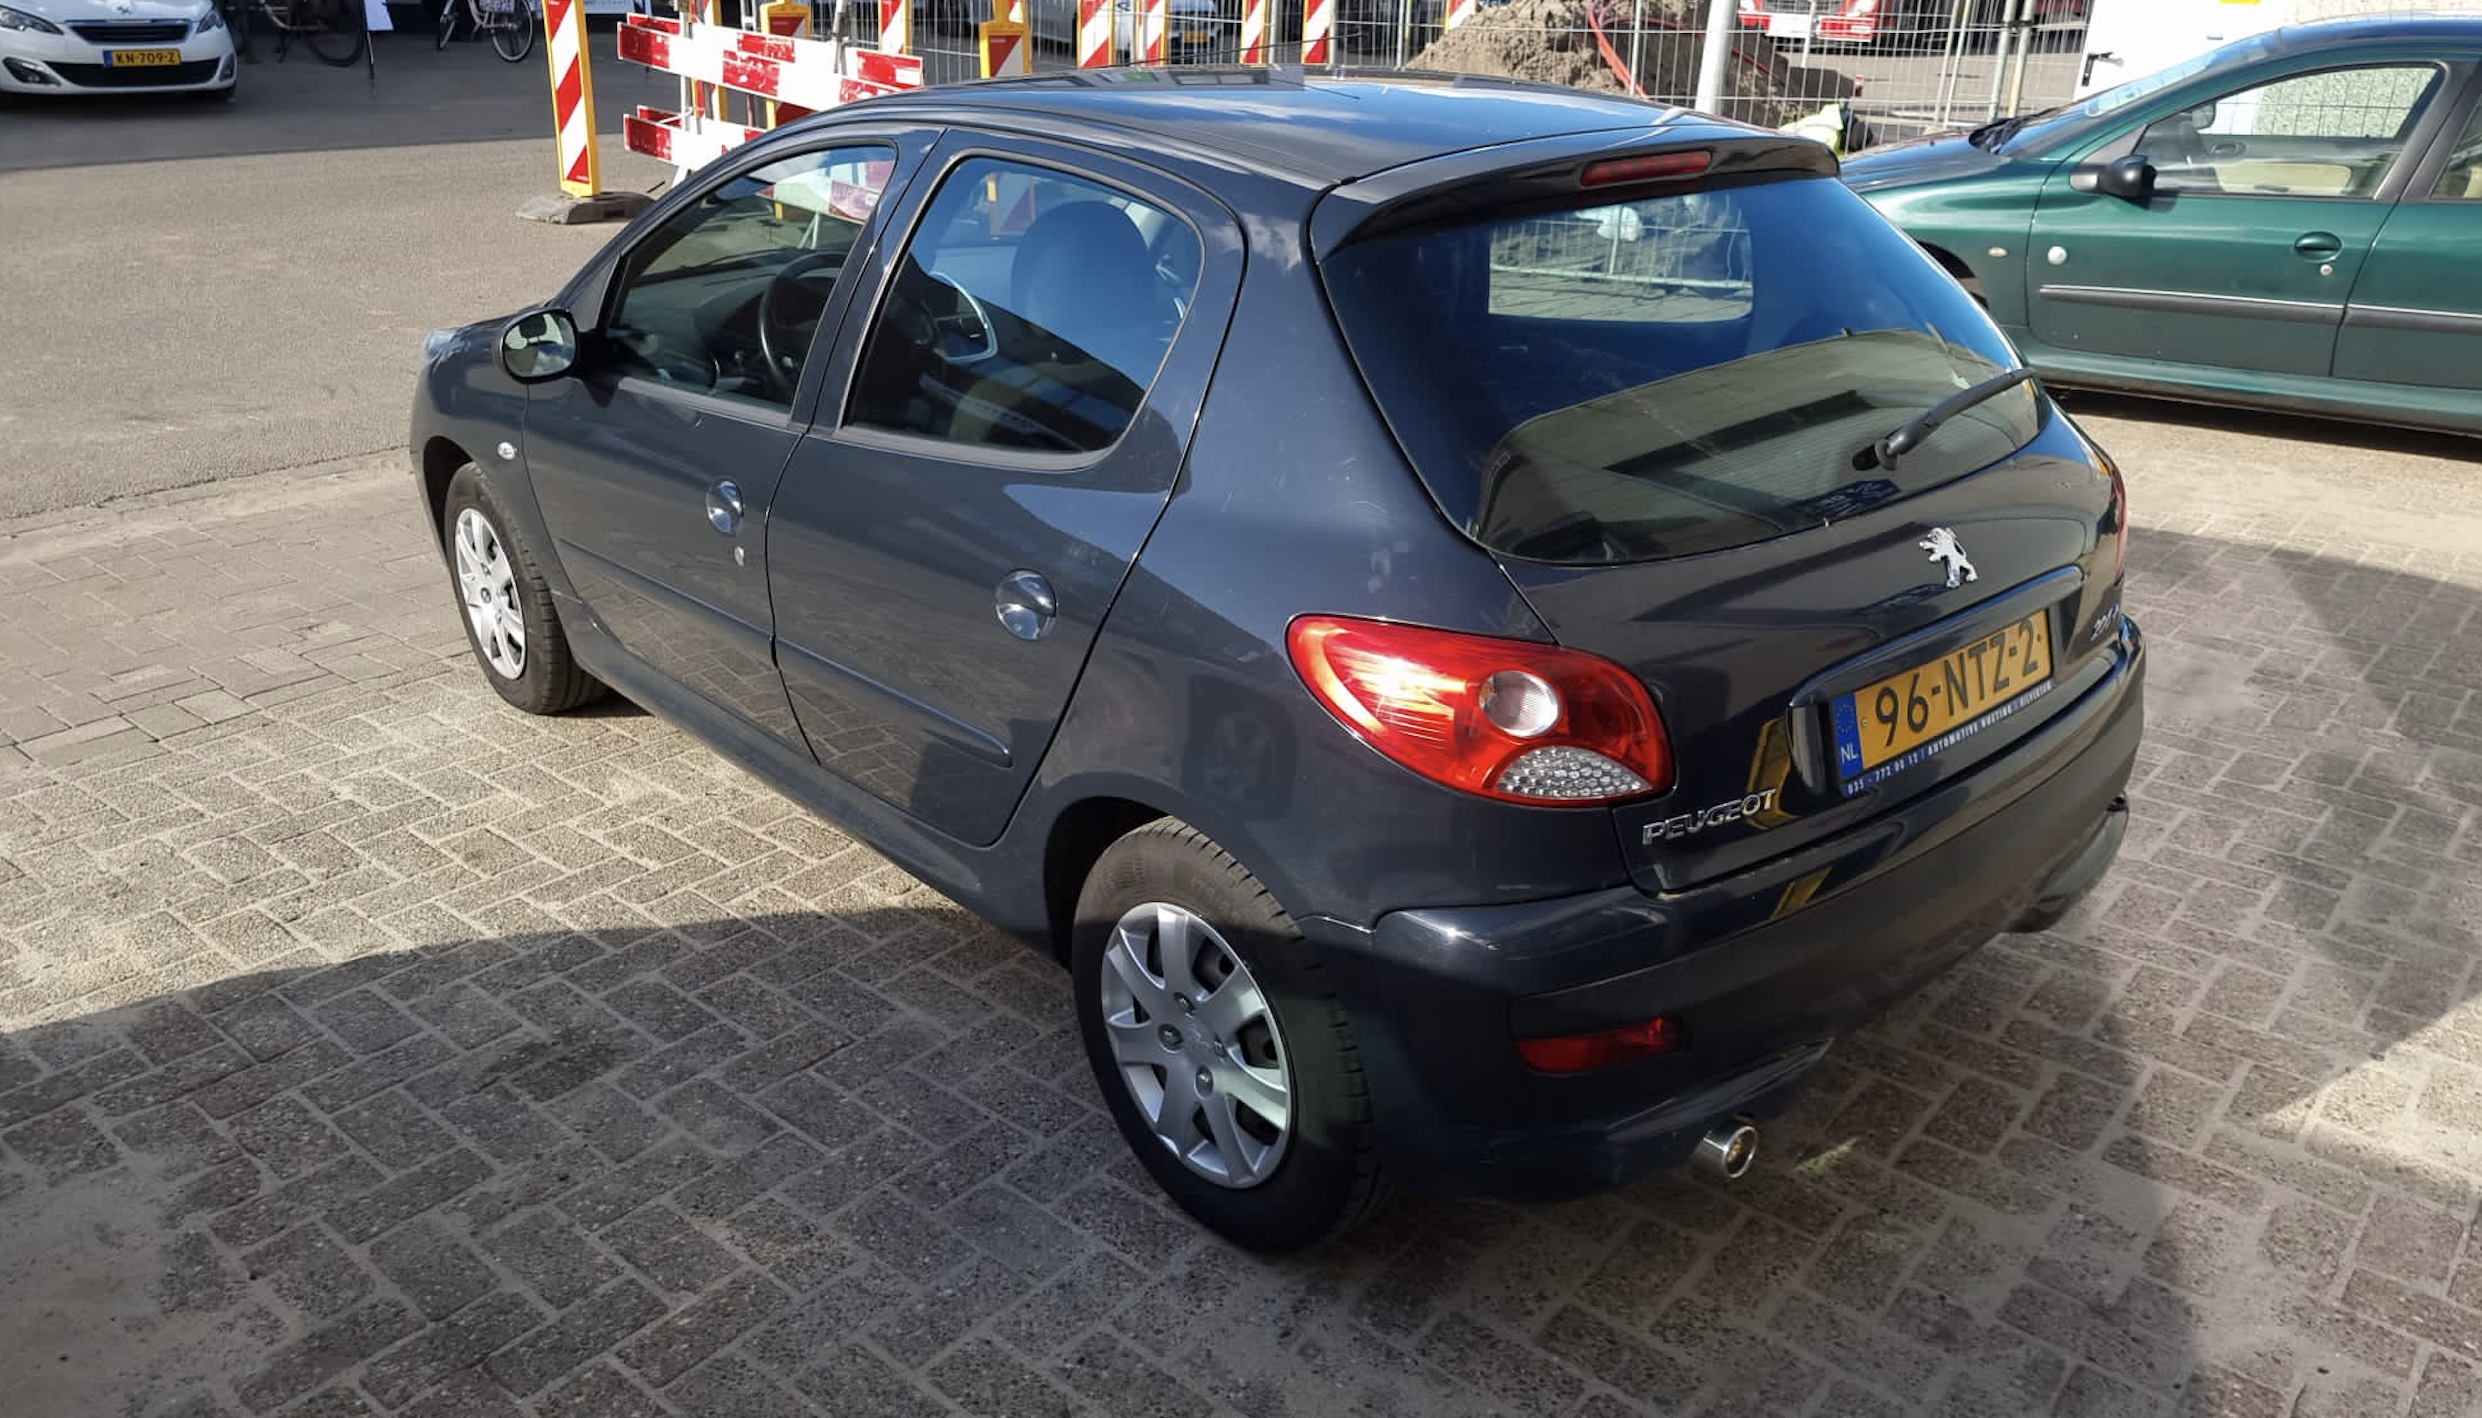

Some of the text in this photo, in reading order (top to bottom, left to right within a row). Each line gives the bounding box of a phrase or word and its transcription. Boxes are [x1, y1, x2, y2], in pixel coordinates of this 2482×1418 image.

[1875, 619, 2039, 747] 96-NTZ-2
[1840, 741, 1859, 764] NL
[1927, 720, 1979, 757] AUTOMOTIVE
[1642, 788, 1776, 845] PEUGEOT
